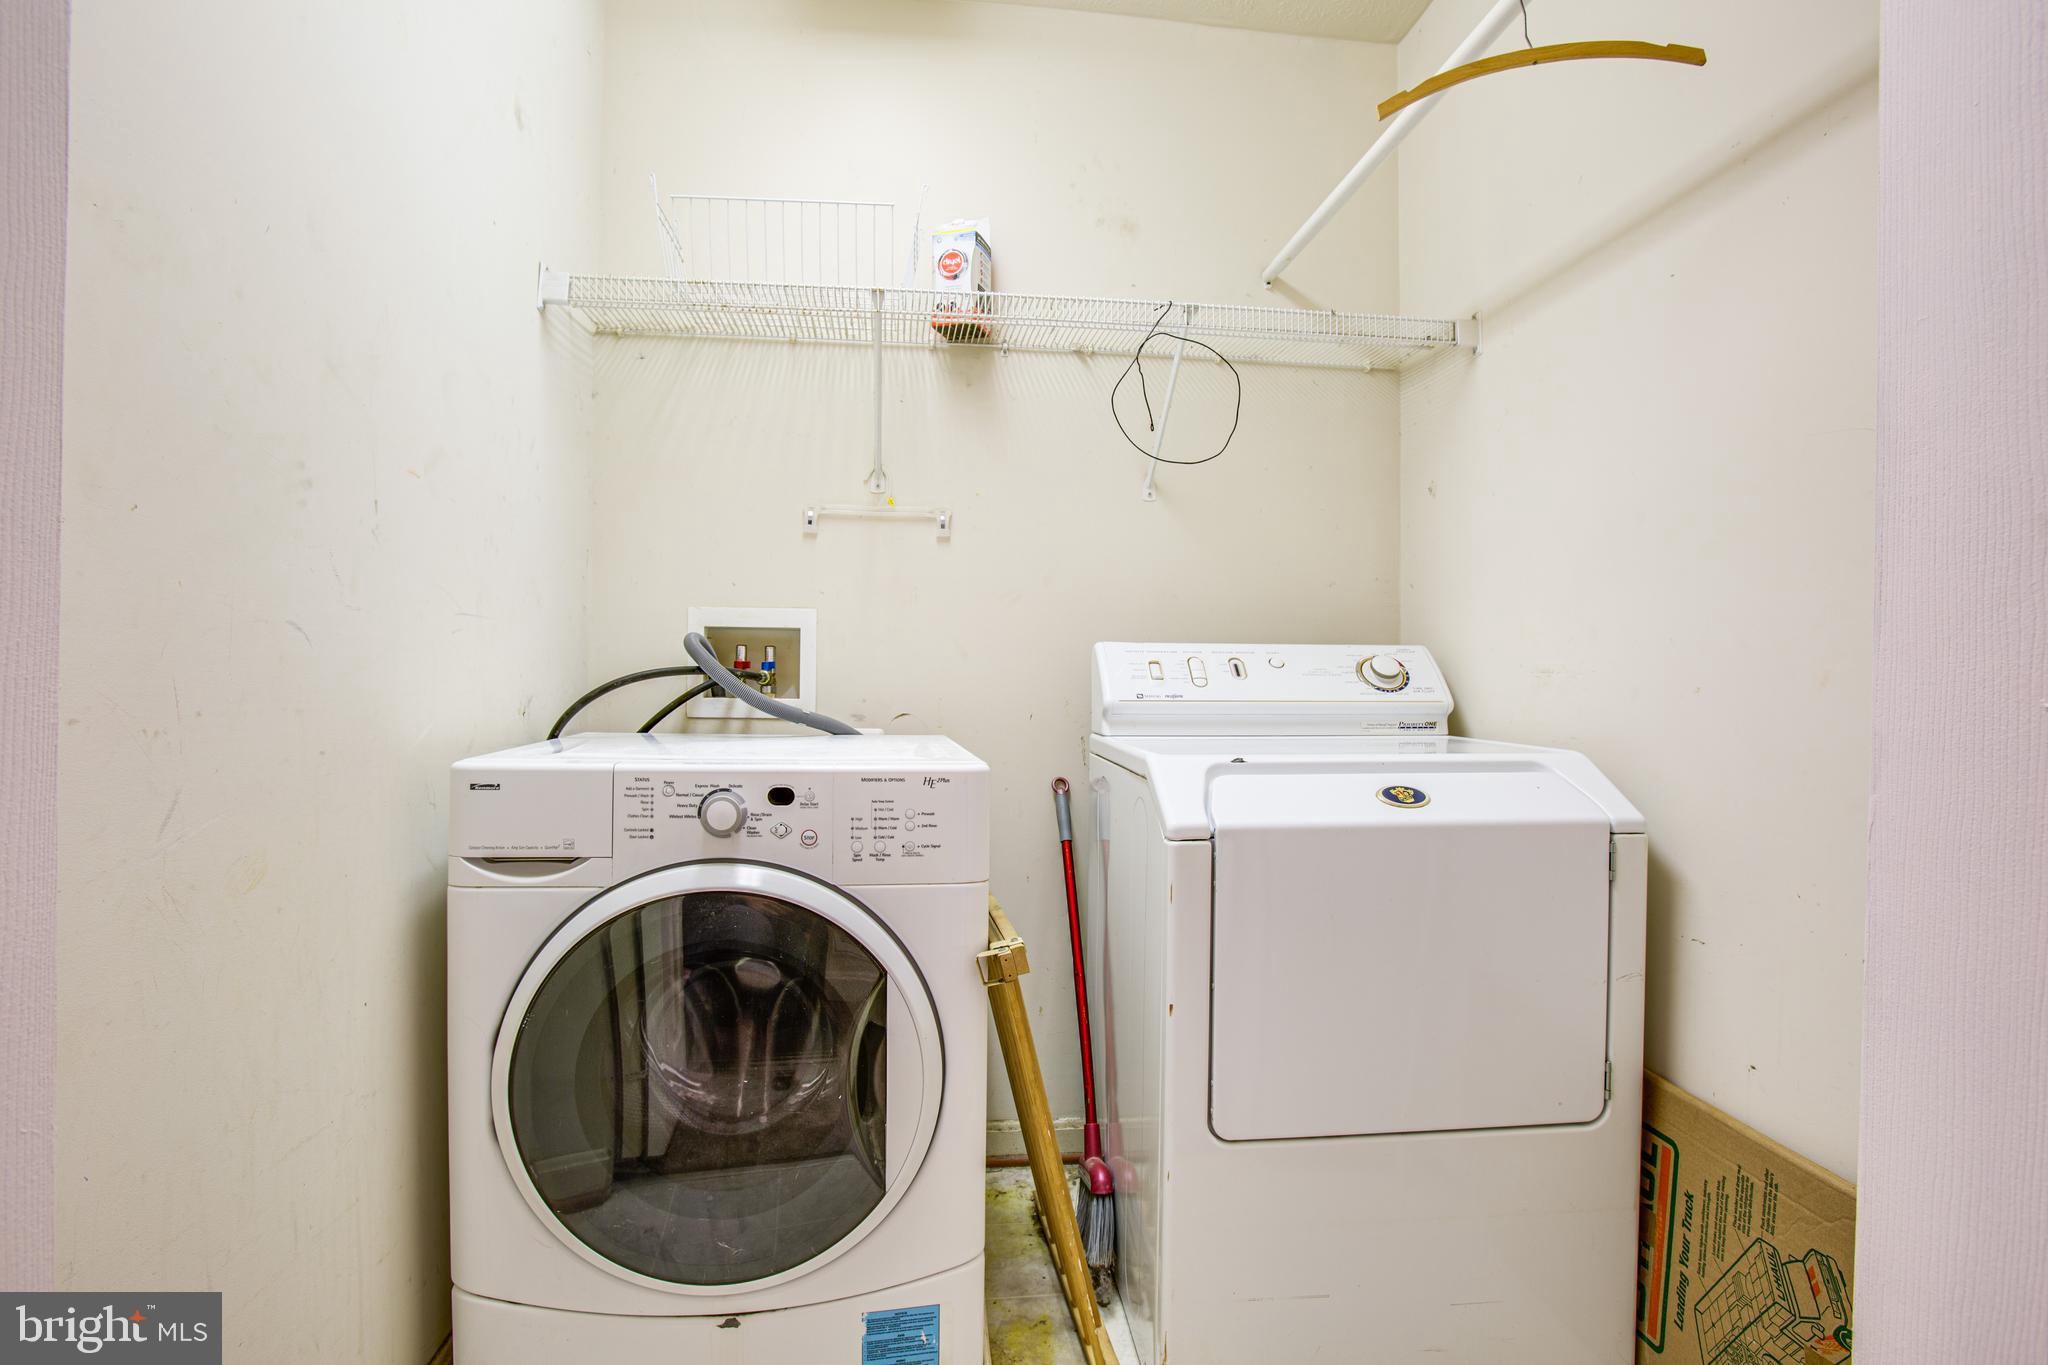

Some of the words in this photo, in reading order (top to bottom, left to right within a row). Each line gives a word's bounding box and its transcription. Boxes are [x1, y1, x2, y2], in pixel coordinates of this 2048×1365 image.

[1682, 1189, 1694, 1232] Truck
[1679, 1233, 1690, 1269] Your
[1674, 1270, 1689, 1332] Loading
